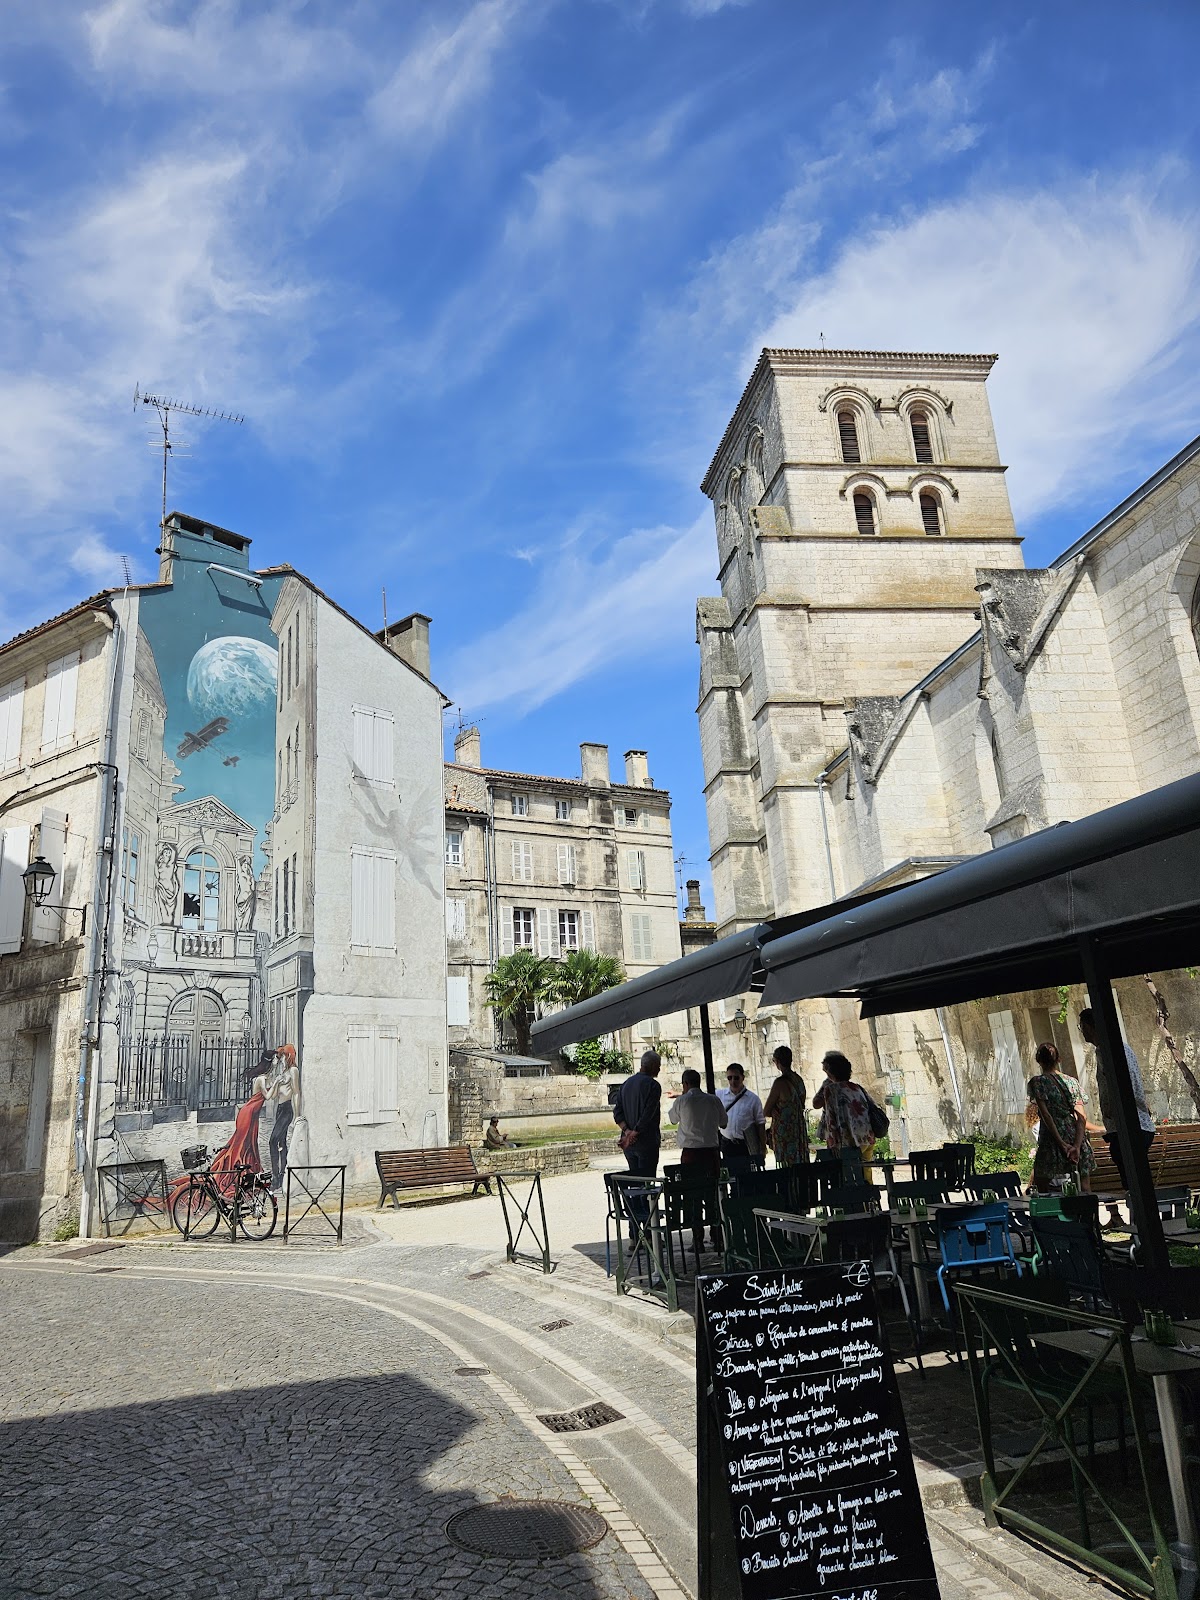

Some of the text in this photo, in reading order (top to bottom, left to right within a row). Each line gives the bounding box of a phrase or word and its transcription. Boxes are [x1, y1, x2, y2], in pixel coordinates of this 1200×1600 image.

[743, 1275, 780, 1301] Saint
[777, 1273, 804, 1301] André
[748, 1309, 758, 1317] au
[836, 1293, 843, 1308] le
[799, 1326, 807, 1337] de
[808, 1321, 839, 1335] concombre
[850, 1317, 873, 1331] menthe
[761, 1419, 769, 1432] de
[770, 1417, 785, 1436] porc
[783, 1430, 791, 1440] de
[789, 1429, 803, 1440] terre
[810, 1421, 833, 1436] tomates
[852, 1416, 862, 1425] au
[788, 1445, 816, 1464] Salade
[827, 1499, 836, 1514] de
[864, 1496, 873, 1505] au
[875, 1487, 888, 1504] lait
[833, 1524, 848, 1535] aux
[851, 1515, 877, 1538] fraises
[783, 1549, 808, 1568] chocolat
[820, 1543, 840, 1559] sésame
[843, 1538, 849, 1553] et
[866, 1538, 874, 1549] de
[817, 1549, 898, 1585] ganache chocolat blanc
